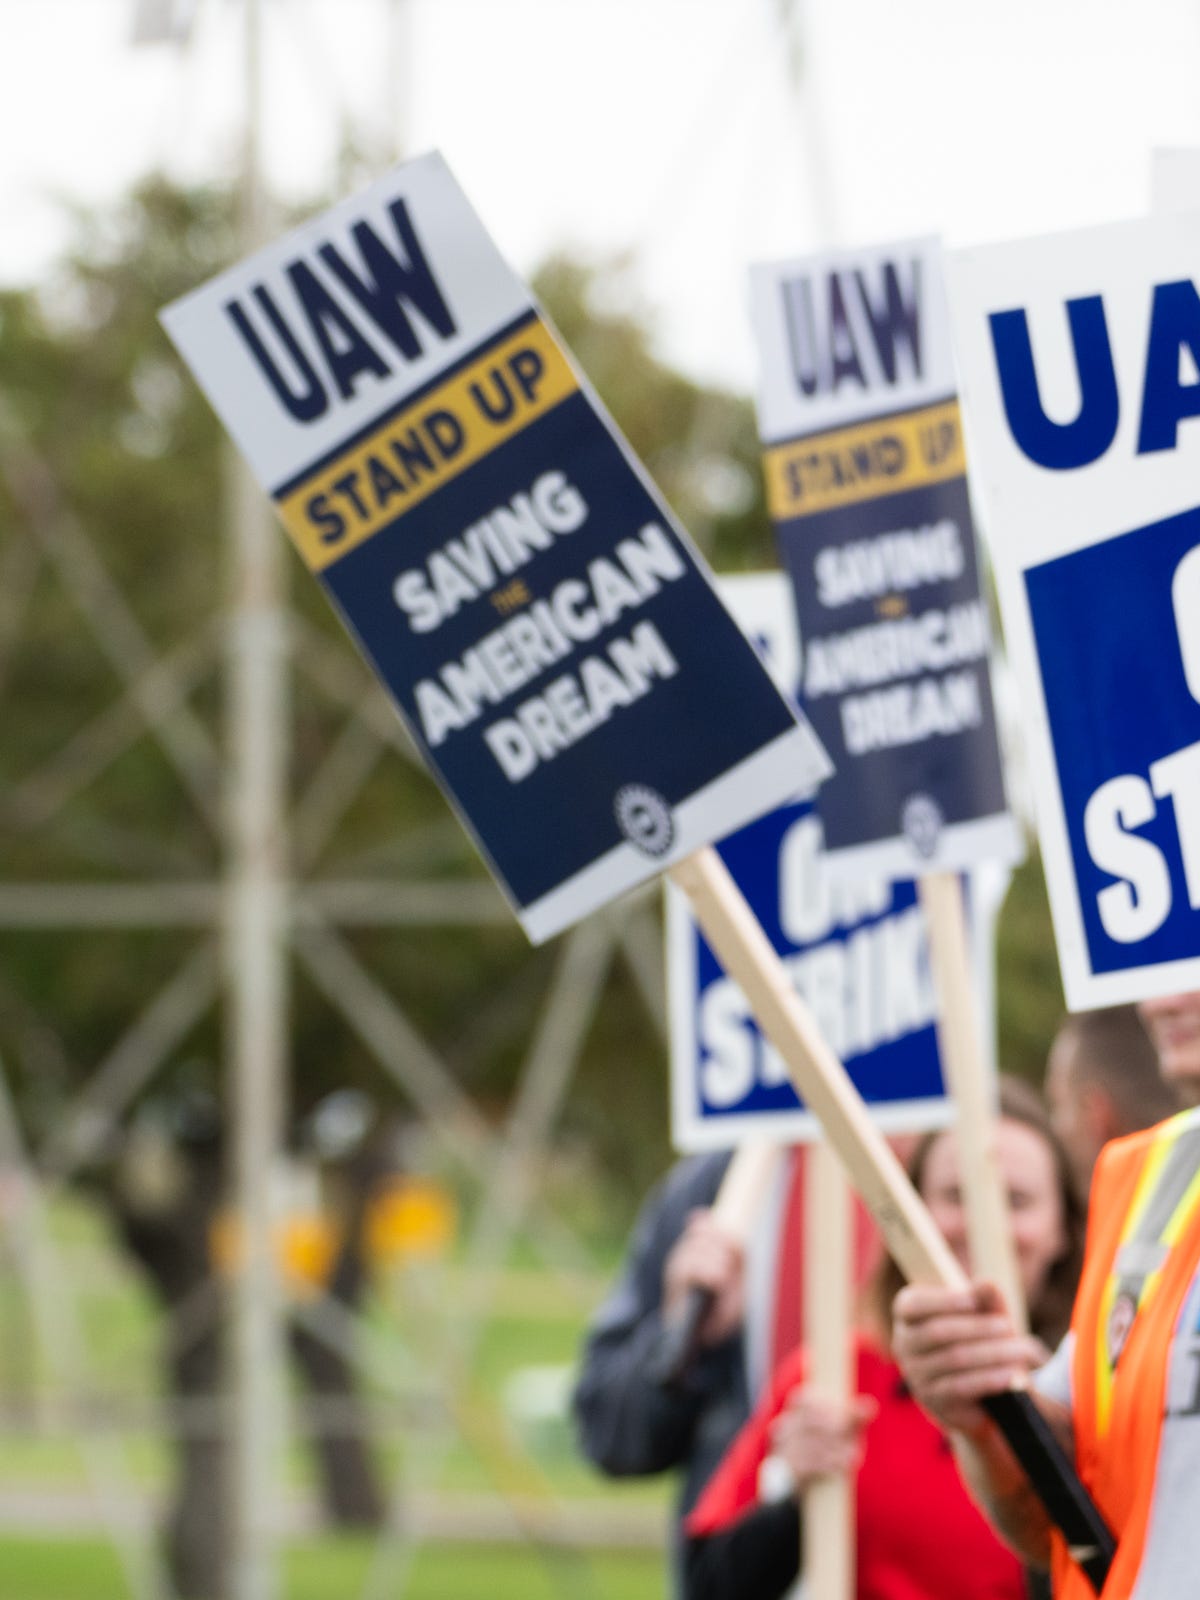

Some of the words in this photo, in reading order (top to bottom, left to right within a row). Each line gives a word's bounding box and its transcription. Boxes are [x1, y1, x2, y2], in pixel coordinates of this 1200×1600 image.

[226, 197, 458, 425] UAW
[780, 258, 924, 398] UAW
[304, 408, 466, 546] STAND
[467, 346, 545, 426] UP
[784, 436, 908, 500] STAND
[393, 472, 588, 633] SAVING
[814, 522, 965, 610] SAVING
[414, 524, 685, 746] AMERICAN
[484, 622, 678, 782] DREAM
[700, 898, 945, 1108] SRIK
